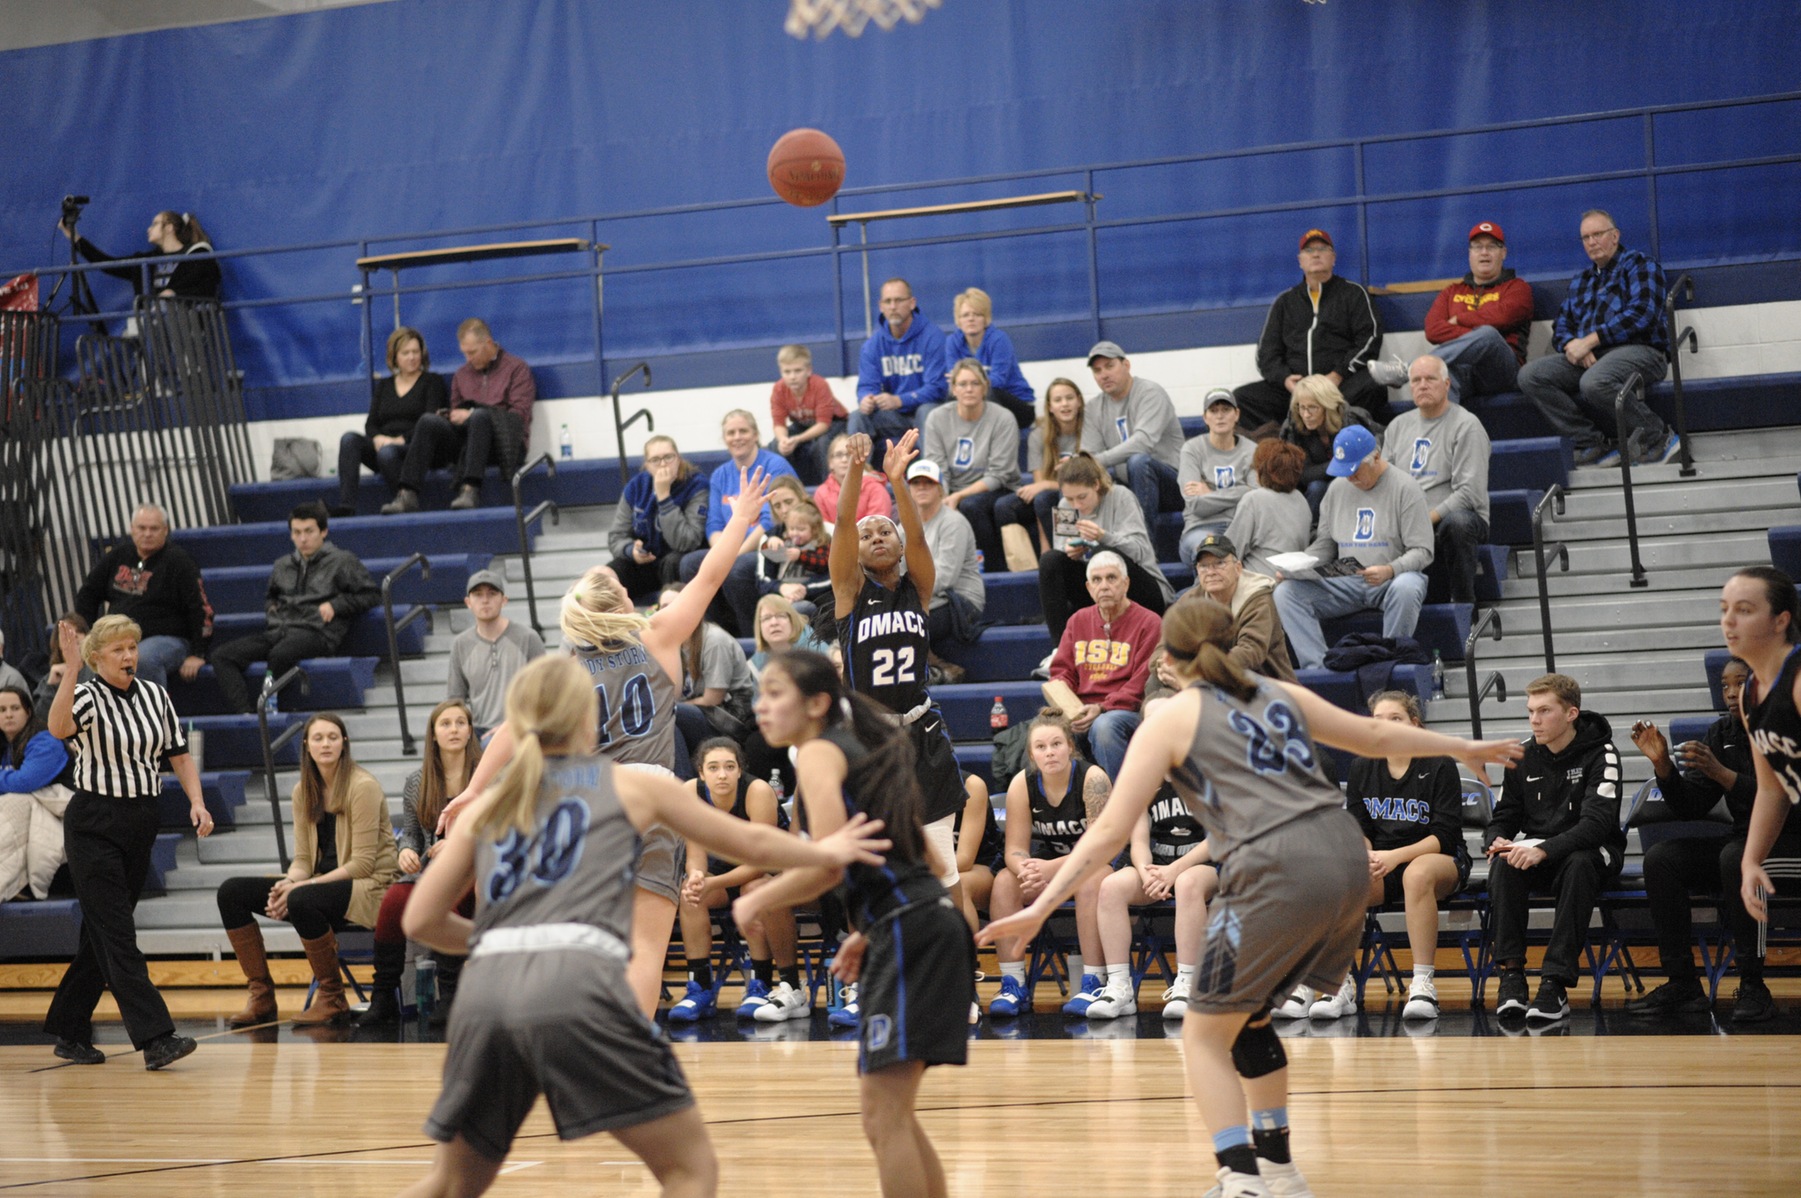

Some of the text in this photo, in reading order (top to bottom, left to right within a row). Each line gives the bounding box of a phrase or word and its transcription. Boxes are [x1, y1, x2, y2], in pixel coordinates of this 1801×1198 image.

[857, 610, 926, 644] DMACC
[872, 646, 915, 687] 22
[1074, 639, 1131, 666] ISU
[593, 672, 655, 746] 10
